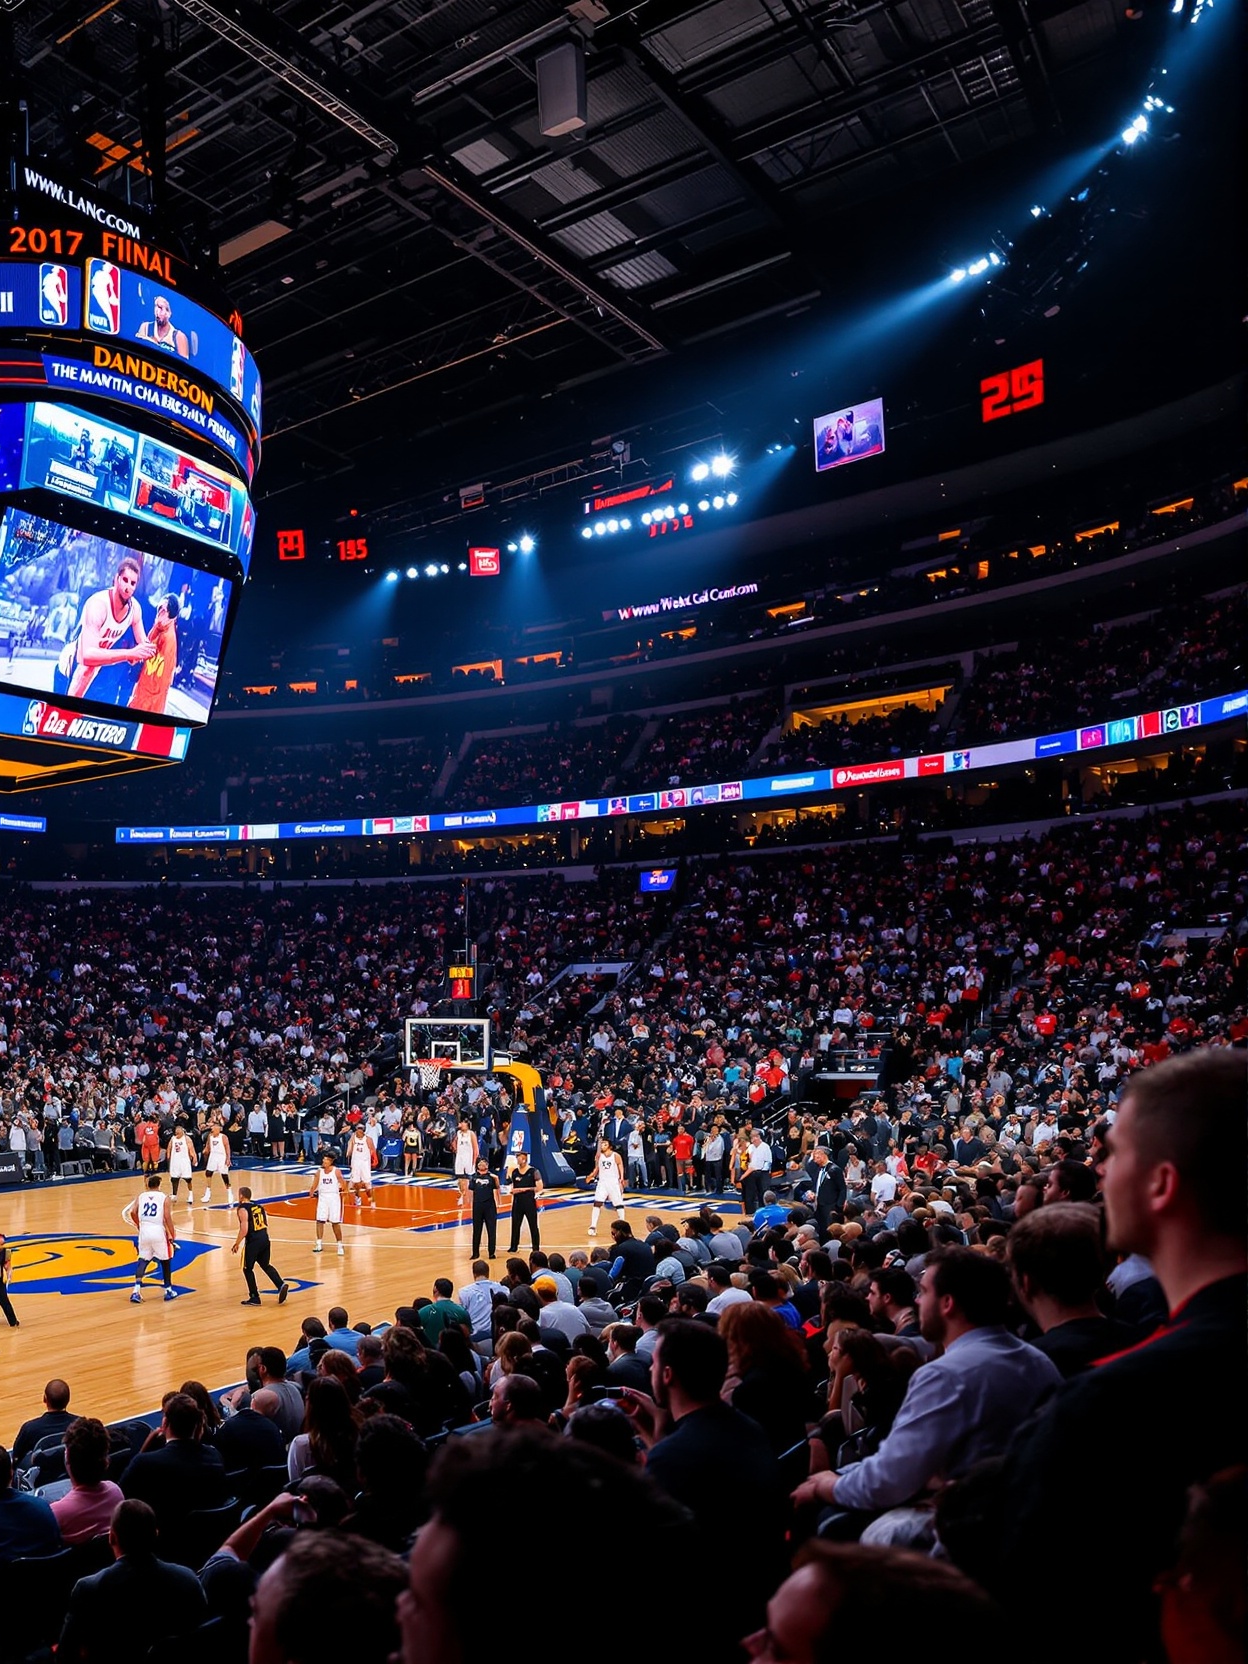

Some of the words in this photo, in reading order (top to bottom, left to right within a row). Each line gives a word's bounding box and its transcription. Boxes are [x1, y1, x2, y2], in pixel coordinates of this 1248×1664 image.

[9, 226, 83, 255] 2017
[52, 363, 79, 380] THE
[93, 345, 214, 414] DANDERSON
